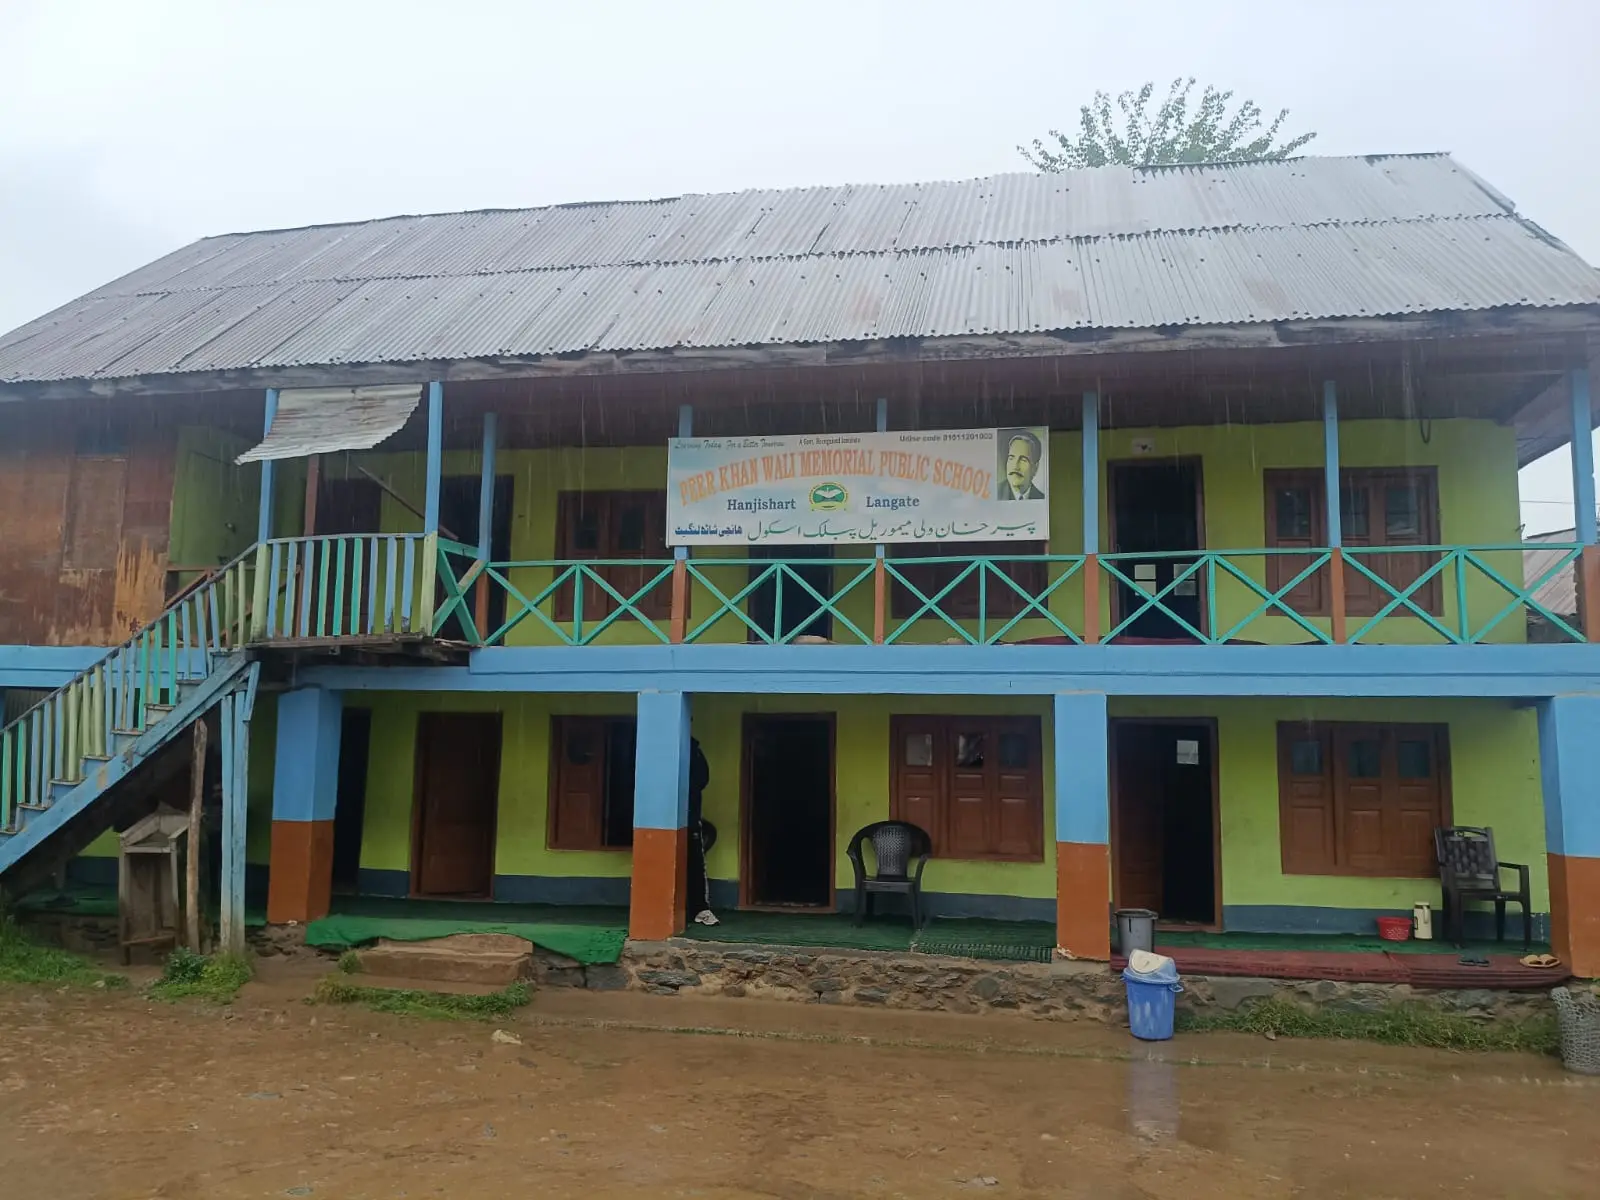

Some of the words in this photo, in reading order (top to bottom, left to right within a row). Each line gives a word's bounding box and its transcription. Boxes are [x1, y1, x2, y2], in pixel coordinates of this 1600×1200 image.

[680, 470, 716, 506] PEER
[719, 457, 758, 492] KHAN
[762, 452, 796, 481] WALI
[799, 449, 875, 477] MEMORIAL
[879, 450, 930, 483] PUBLIC
[932, 457, 993, 499] SCHOOL
[727, 498, 796, 513] Hanjishart
[866, 496, 920, 510] Langate
